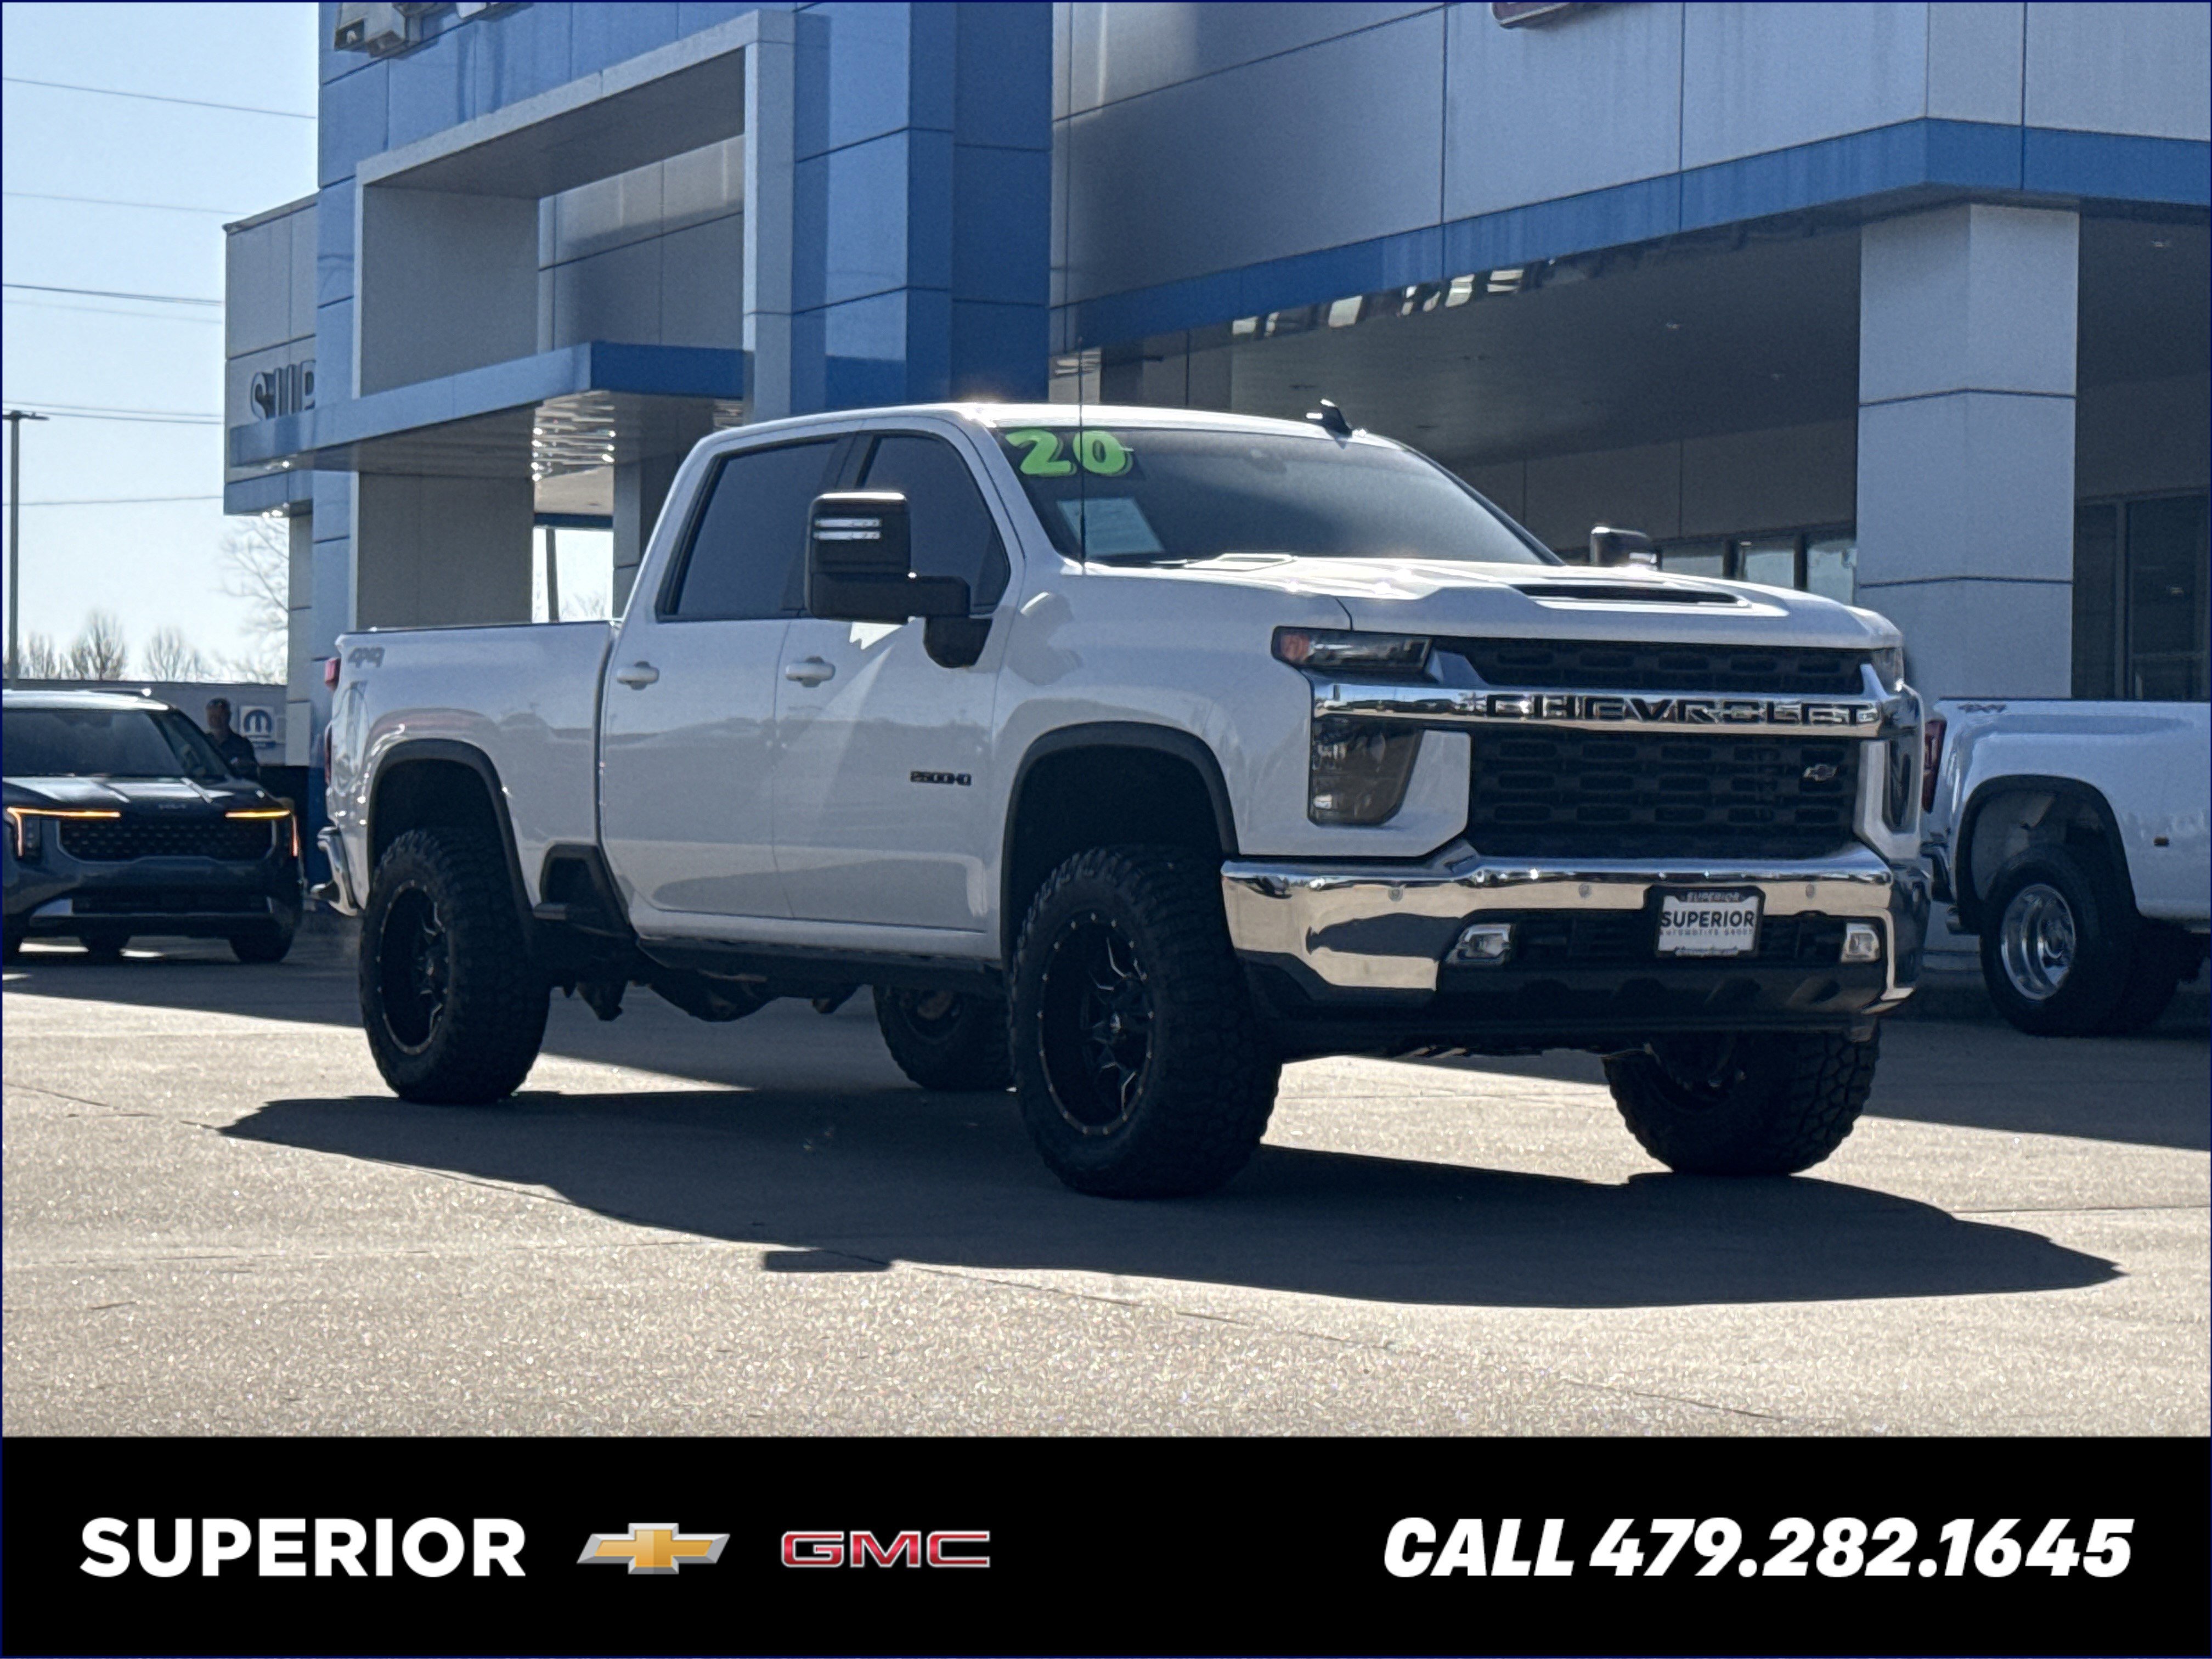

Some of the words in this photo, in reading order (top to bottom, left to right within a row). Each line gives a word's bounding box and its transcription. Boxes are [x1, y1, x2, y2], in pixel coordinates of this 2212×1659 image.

[1005, 429, 1134, 477] 20
[1486, 693, 1874, 726] CHEVROLET
[1660, 910, 1755, 928] SUPERIOR
